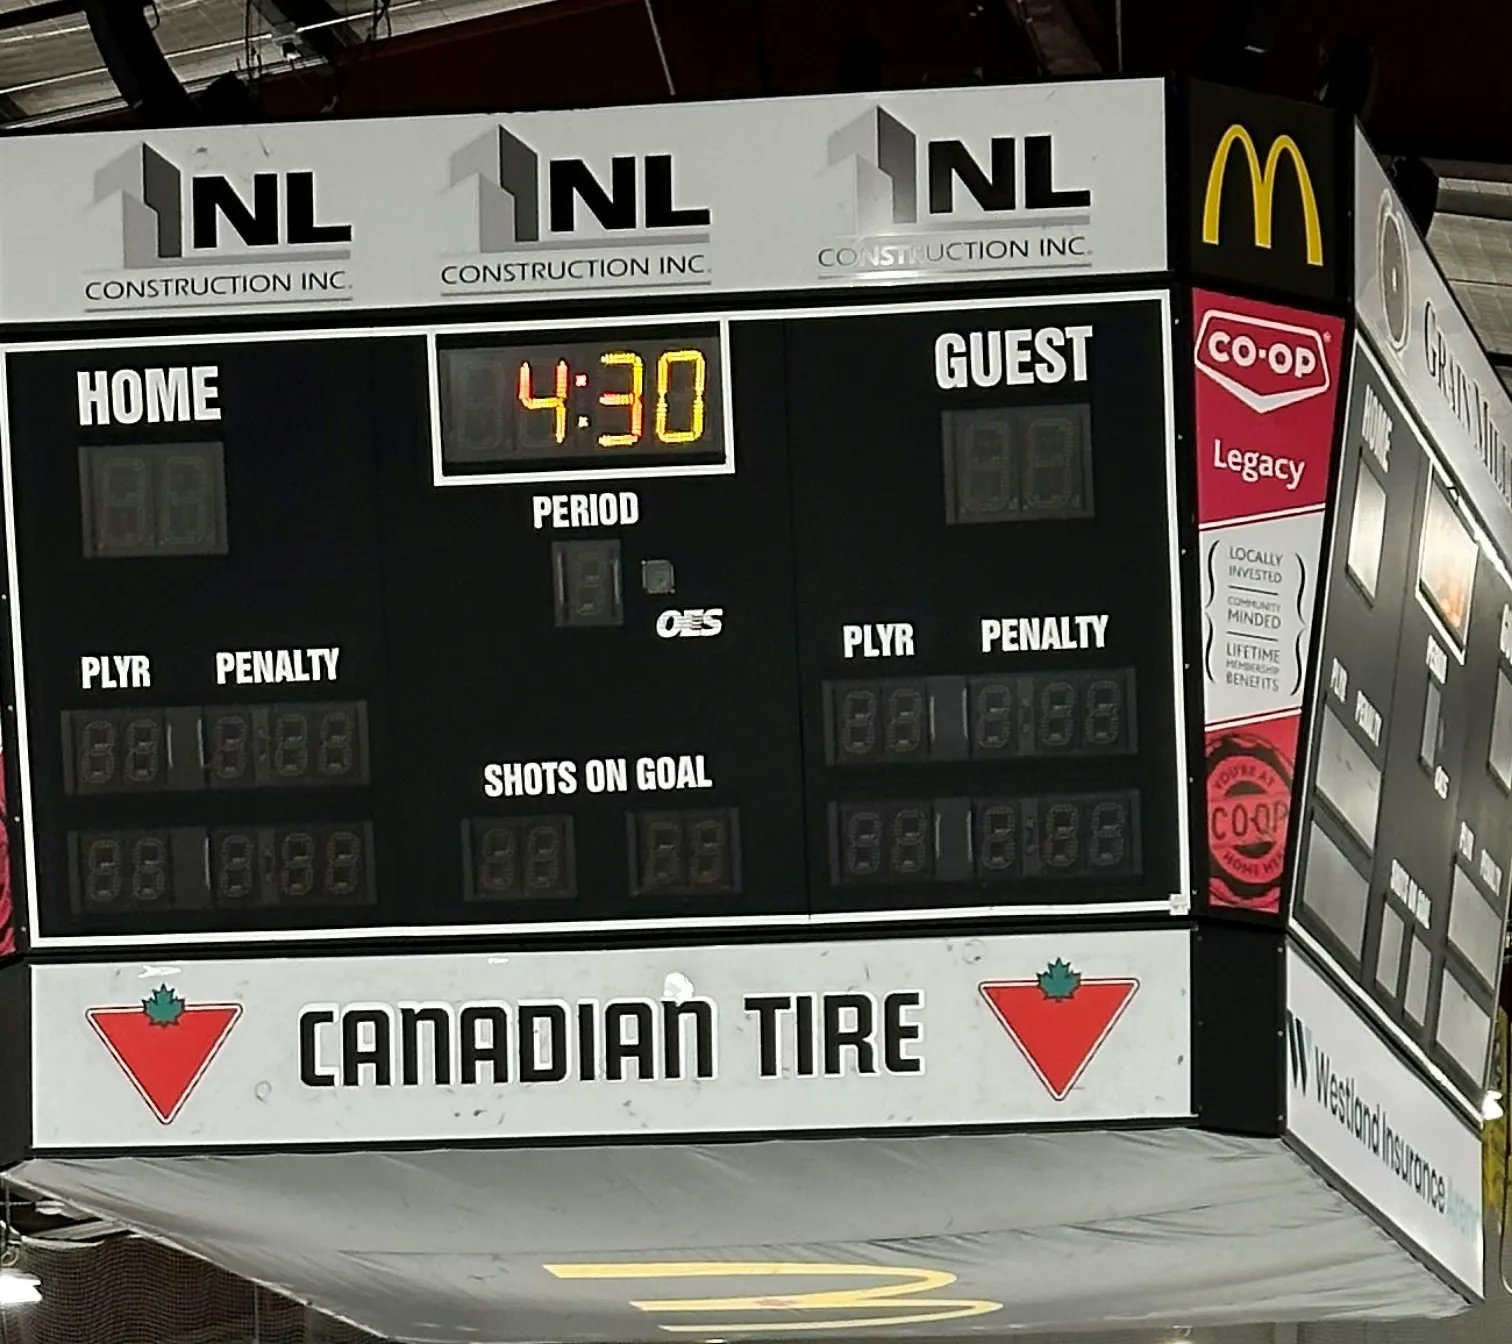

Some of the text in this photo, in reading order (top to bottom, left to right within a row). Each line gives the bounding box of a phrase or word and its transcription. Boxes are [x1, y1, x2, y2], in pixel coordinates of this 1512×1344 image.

[550, 155, 711, 233] NL
[928, 134, 1091, 214] NL
[192, 171, 352, 249] NL
[441, 254, 713, 286] CONSTRUCTION INC.
[818, 236, 1093, 269] CONSTRUCTION INC.
[85, 270, 353, 301] CONSTRUCTION INC.
[935, 325, 1093, 389] GUEST
[1208, 330, 1317, 380] CO-OP
[76, 366, 223, 426] HOME
[517, 348, 708, 447] 4:30
[1213, 437, 1306, 490] Legacy
[532, 492, 640, 529] PERIOD
[1228, 545, 1284, 568] LOCALLY
[1228, 563, 1283, 585] INVESTED
[656, 608, 724, 638] OES
[842, 615, 1109, 659] PLYR PENALTY
[1227, 608, 1281, 630] MINDED
[81, 646, 340, 689] PLYR PENALTY
[1226, 643, 1280, 664] LIFETIME
[1226, 672, 1279, 693] BENEFITS
[484, 755, 713, 798] SHOTS ON GOAL
[301, 986, 926, 1088] CANADIAN TIRE
[1314, 1044, 1381, 1157] Westland
[1383, 1110, 1446, 1215] Insurance
